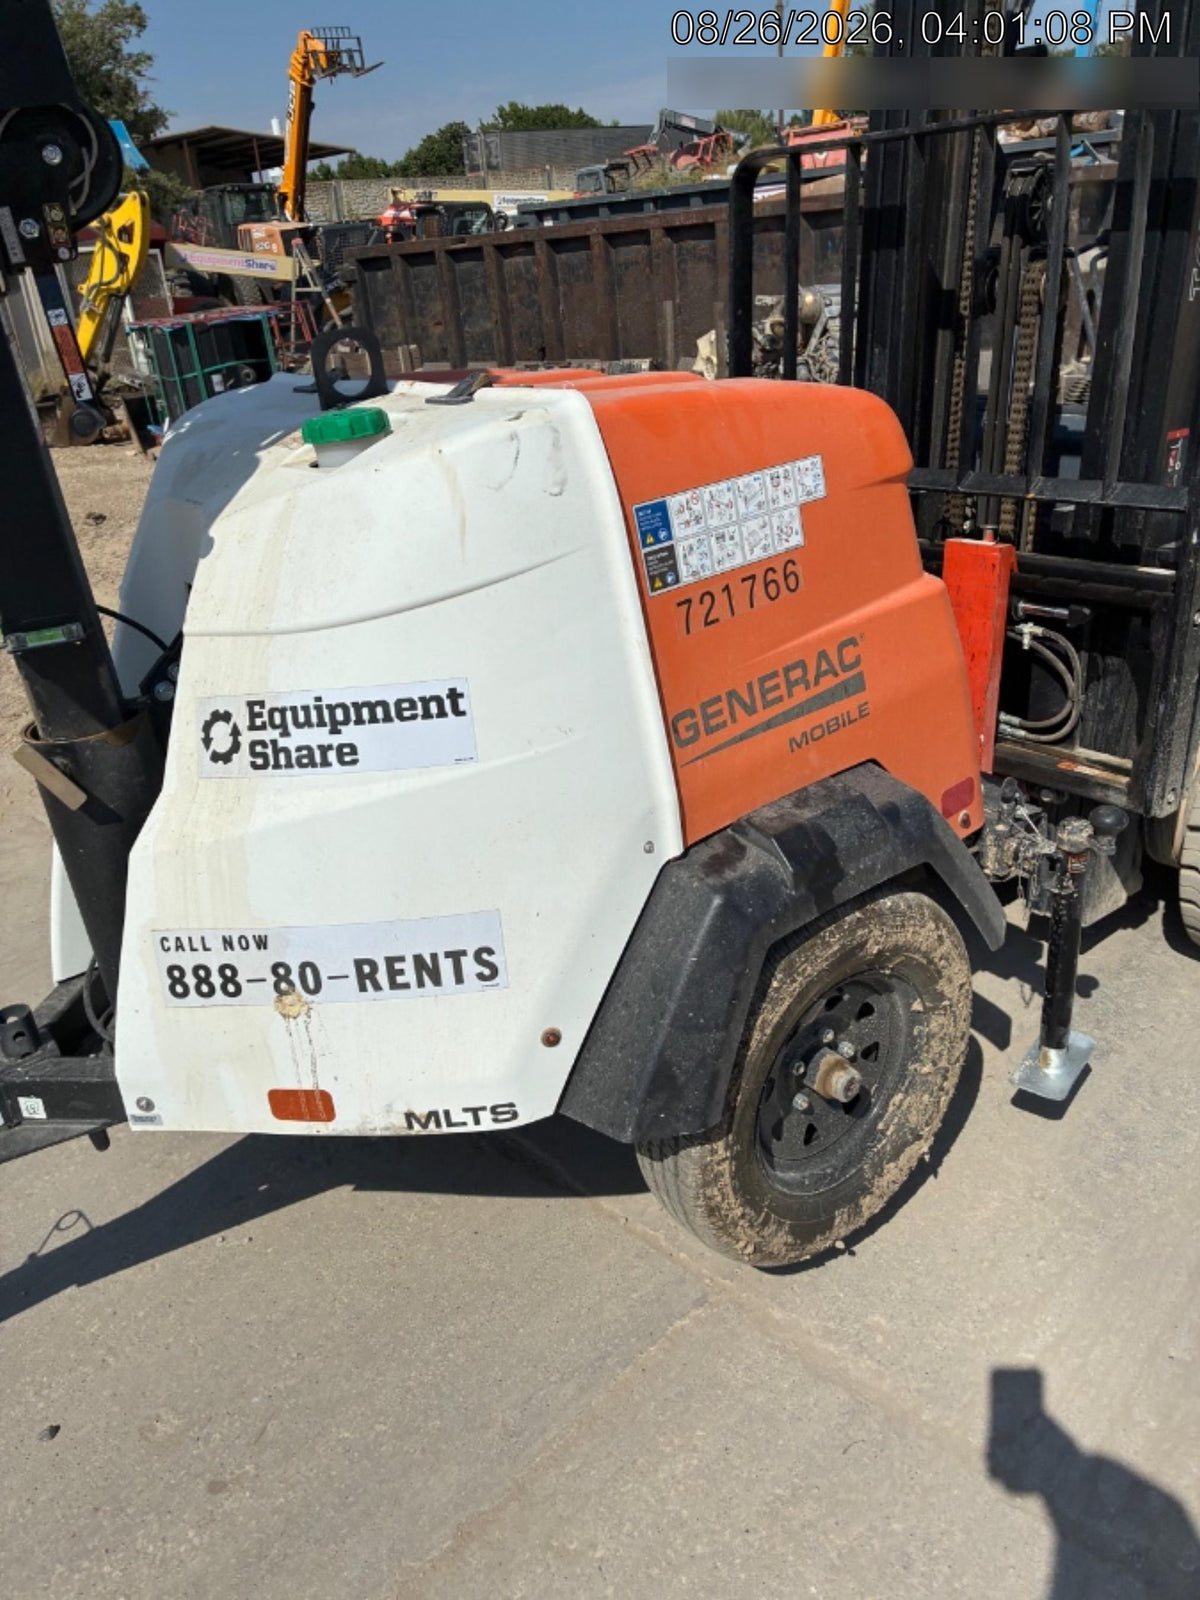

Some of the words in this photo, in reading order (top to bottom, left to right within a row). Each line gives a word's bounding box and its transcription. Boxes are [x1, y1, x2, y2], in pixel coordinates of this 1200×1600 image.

[676, 558, 800, 635] 721766
[246, 687, 467, 738] Equipment
[671, 636, 862, 749] GENERAC
[788, 701, 871, 753] MOBILE
[248, 739, 360, 771] Share
[159, 935, 213, 953] CALL
[221, 934, 270, 951] NOW
[165, 946, 501, 999] 888-80-RENTS
[404, 1101, 519, 1130] MLTS
